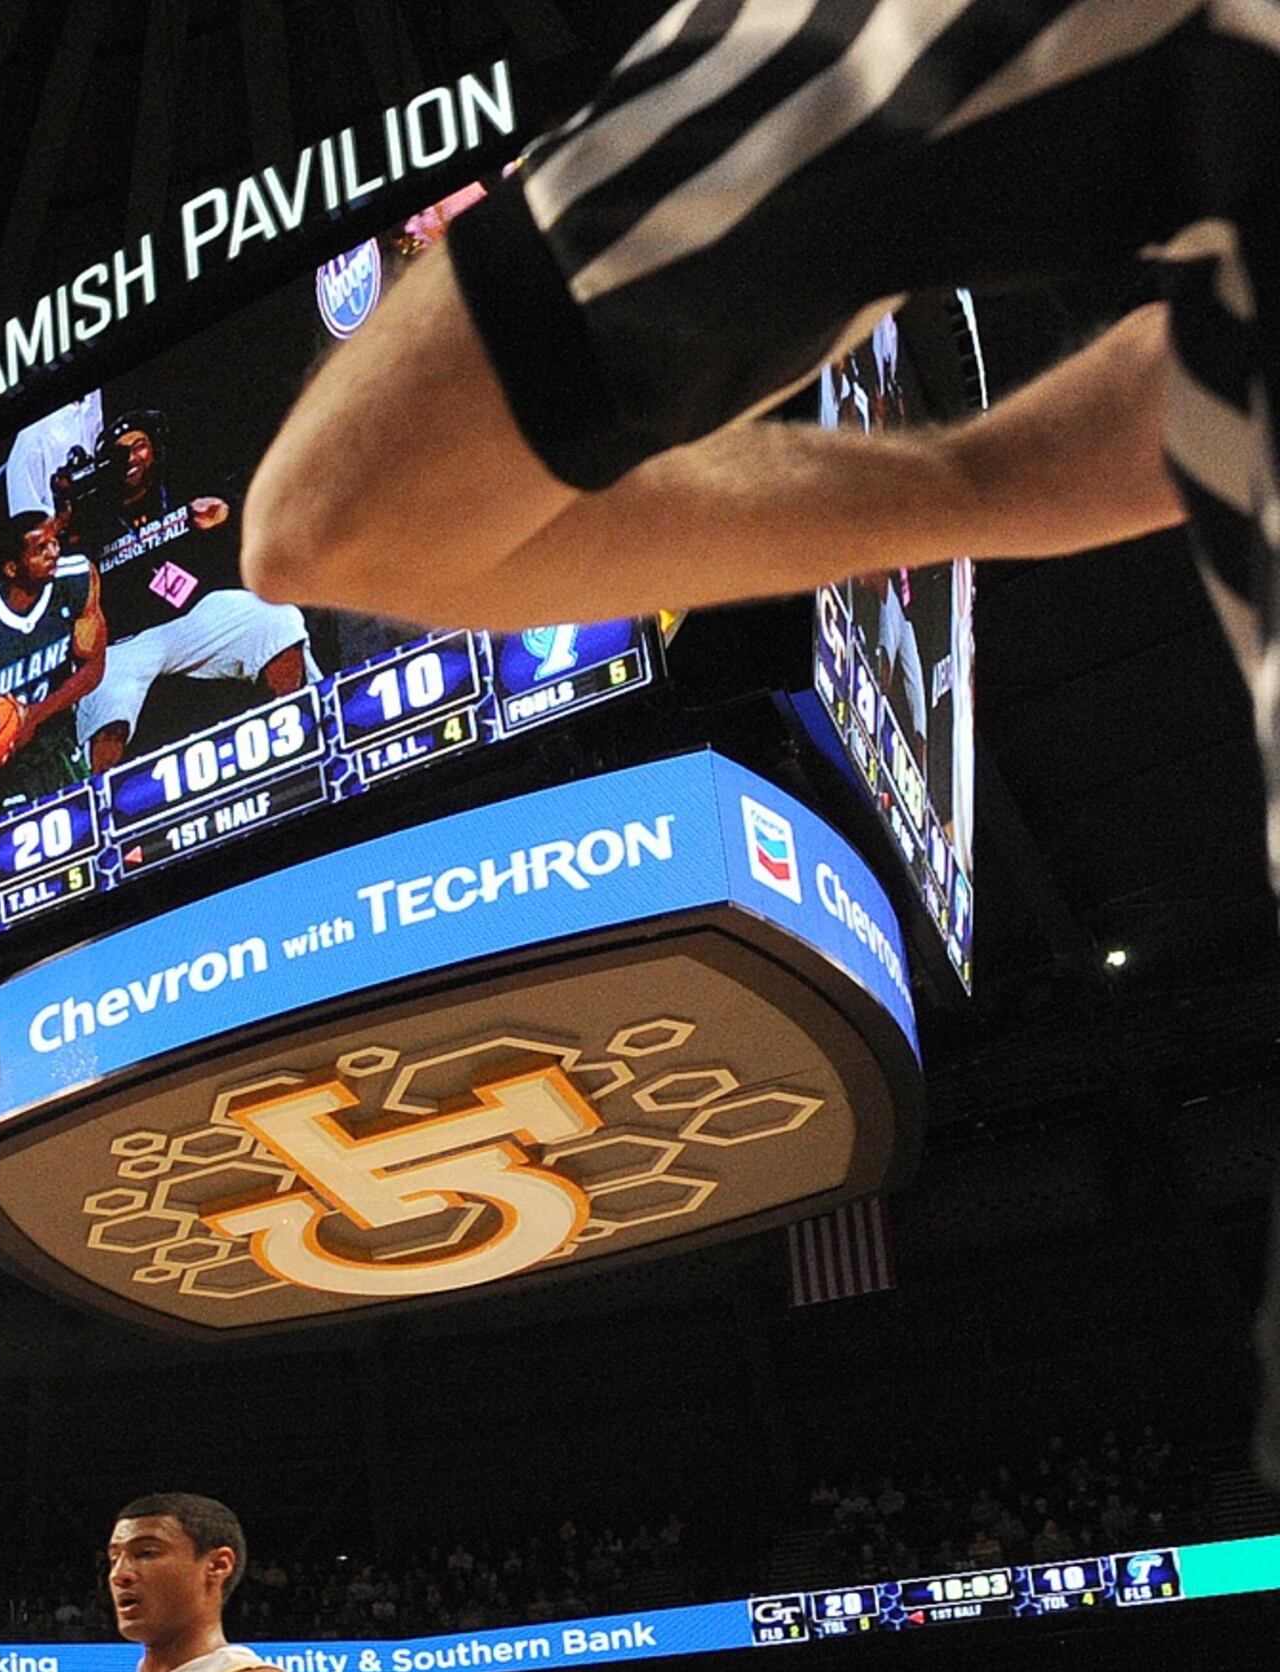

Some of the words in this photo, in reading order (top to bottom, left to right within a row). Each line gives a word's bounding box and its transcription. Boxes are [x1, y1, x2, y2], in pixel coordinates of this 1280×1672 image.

[180, 59, 516, 281] PAVILION
[366, 652, 444, 721] 10
[151, 703, 306, 803] 10:03
[11, 807, 74, 872] 20
[166, 815, 209, 851] 1ST
[213, 791, 271, 834] HALF
[67, 866, 84, 891] 5
[28, 933, 269, 1054] Chevron
[282, 914, 356, 962] with
[357, 814, 674, 937] TECHRON
[816, 862, 904, 986] Chevron
[824, 1593, 862, 1617] 20
[1043, 1565, 1085, 1592] 10
[754, 1602, 801, 1624] GT
[358, 1649, 382, 1672] &
[392, 1636, 551, 1672] Southern
[562, 1620, 657, 1655] Bank
